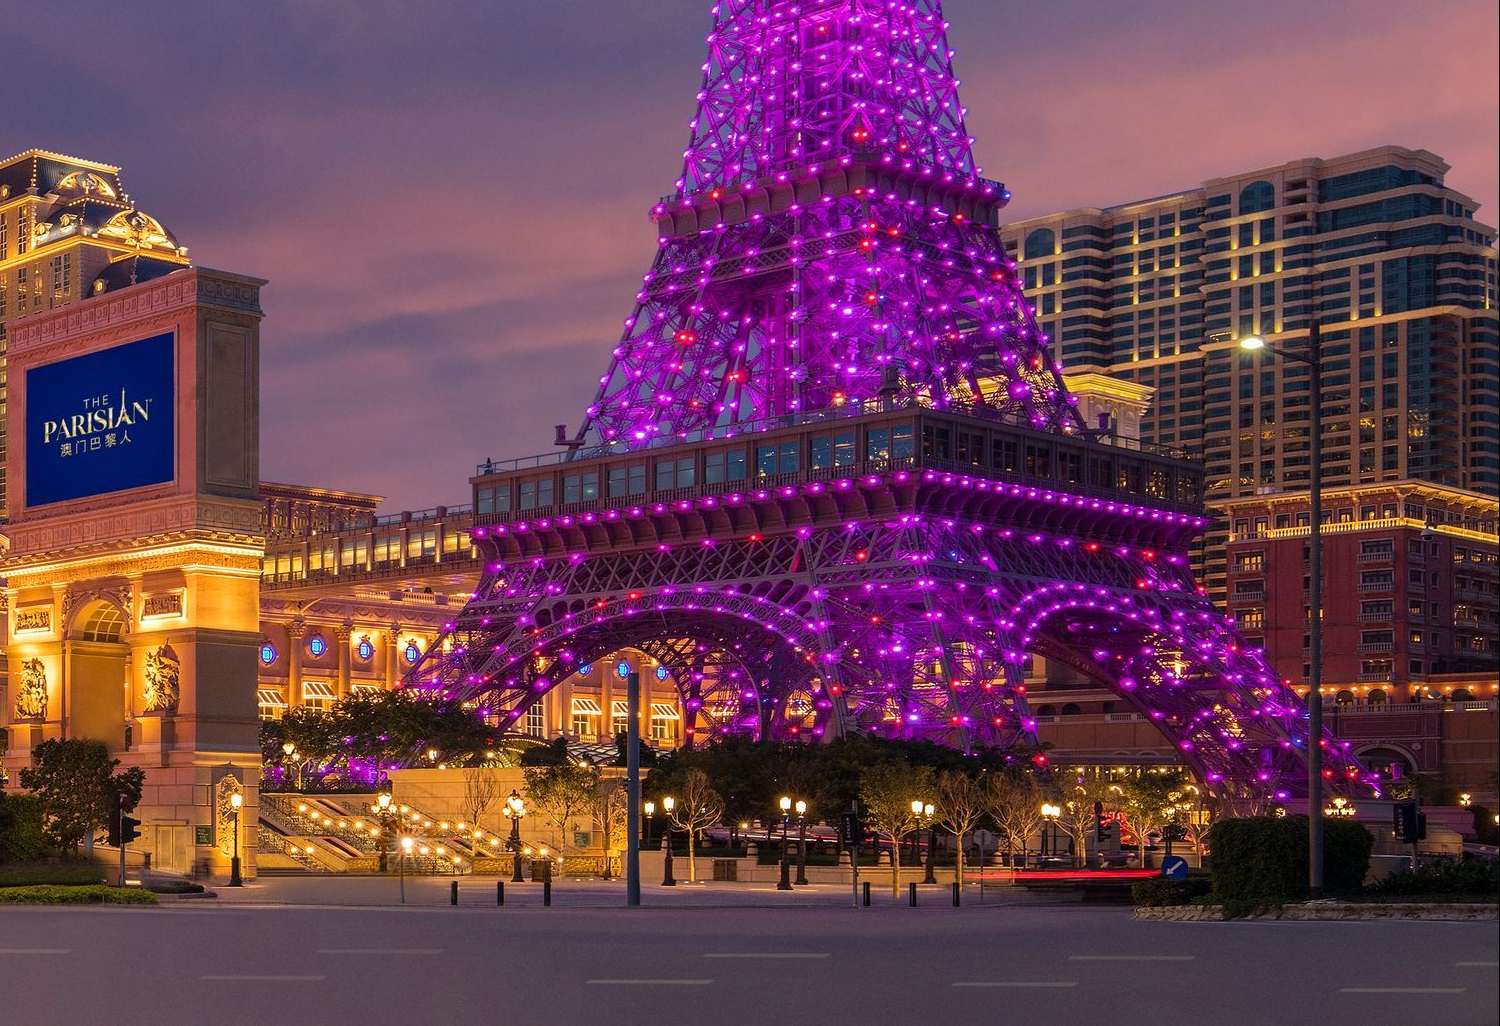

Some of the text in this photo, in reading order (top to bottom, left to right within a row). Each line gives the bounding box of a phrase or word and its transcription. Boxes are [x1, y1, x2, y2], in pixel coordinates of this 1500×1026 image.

[44, 387, 149, 443] PARISIAN
[83, 394, 109, 409] THE
[60, 430, 131, 457] 澳门巴黎人
